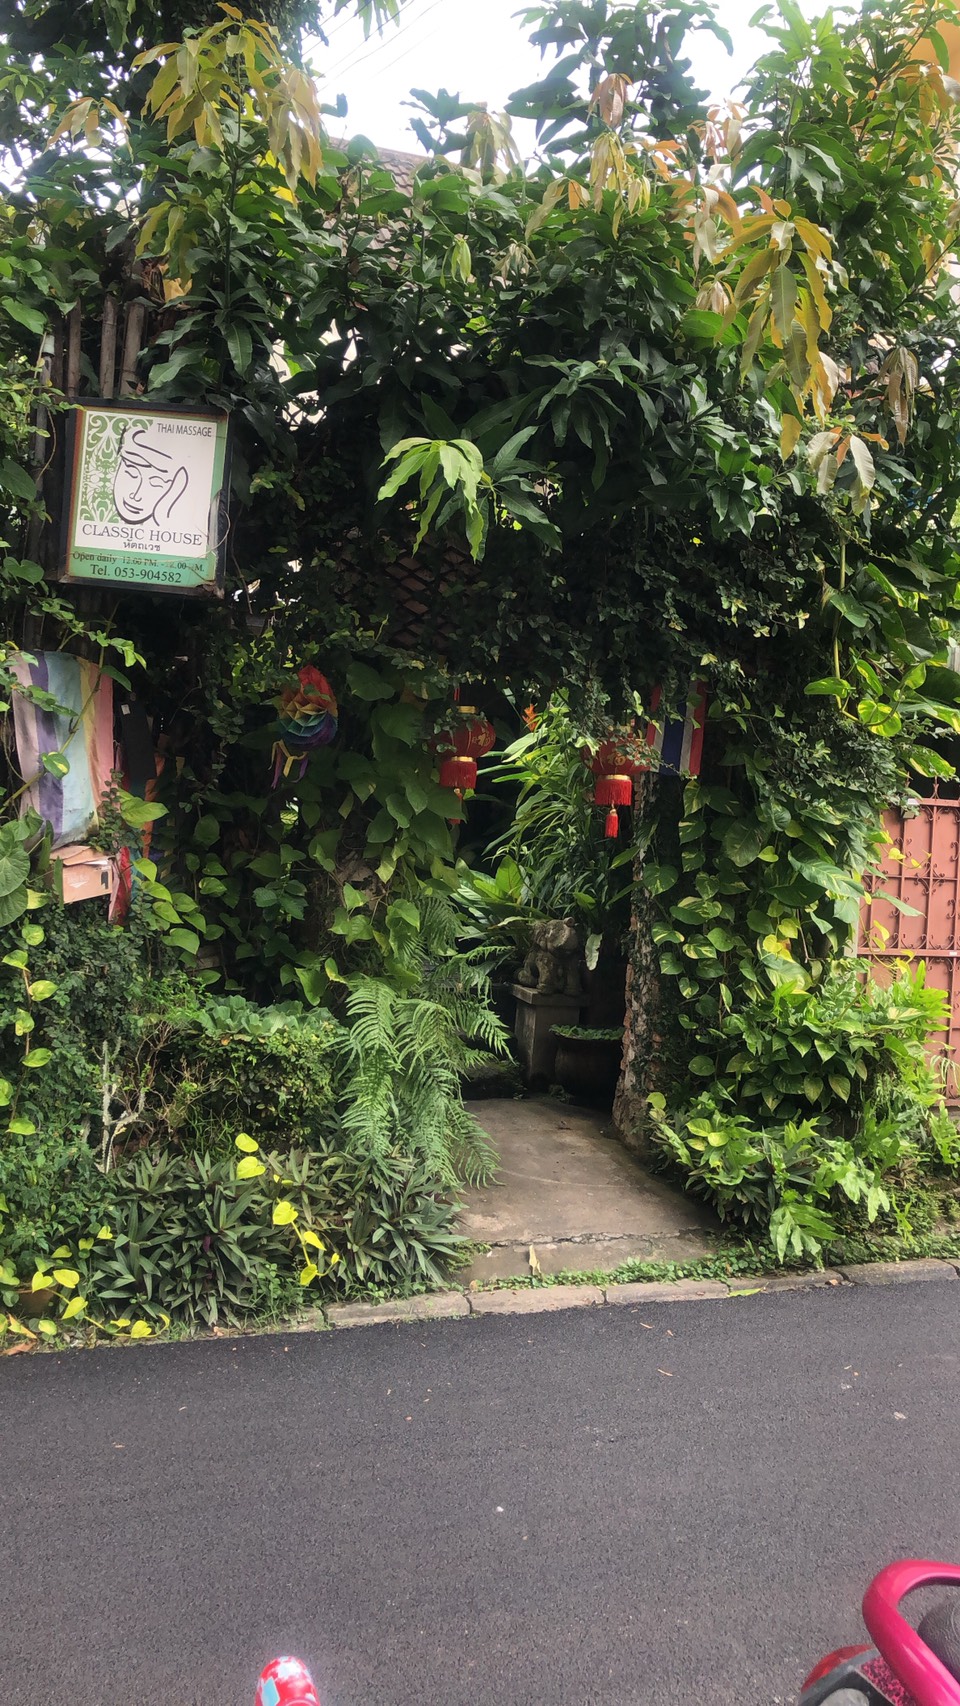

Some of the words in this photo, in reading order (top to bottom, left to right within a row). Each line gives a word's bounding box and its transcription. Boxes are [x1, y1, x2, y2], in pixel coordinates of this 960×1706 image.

[157, 422, 175, 433] THAI
[176, 424, 213, 437] MASSAGE
[82, 523, 145, 540] CLASSIC
[149, 530, 203, 546] HOUSE
[72, 551, 95, 562] Open
[90, 563, 110, 576] Tel.
[114, 566, 182, 584] 053-904582
